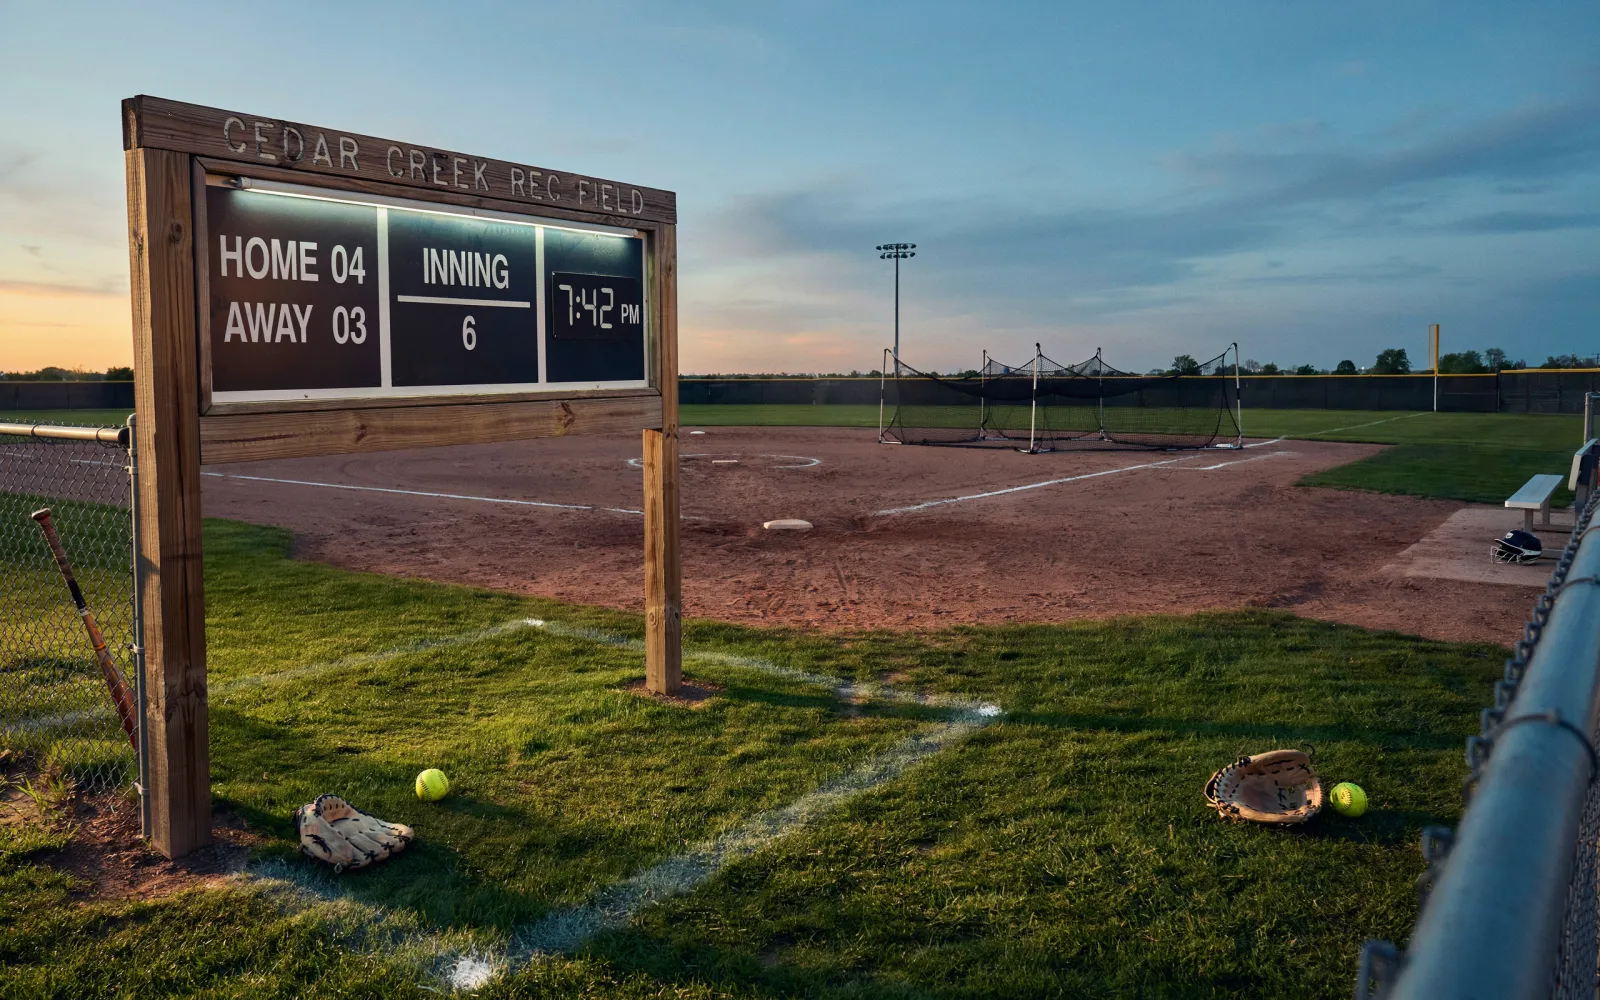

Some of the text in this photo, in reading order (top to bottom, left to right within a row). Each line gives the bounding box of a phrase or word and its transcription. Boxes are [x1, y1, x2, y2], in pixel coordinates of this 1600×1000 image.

[223, 116, 643, 214] CEDAR CREEK REC FIELD
[219, 234, 366, 284] HOME 04
[423, 247, 509, 289] INNING
[224, 301, 367, 344] AWAY 03
[558, 284, 640, 329] 7:42 PM
[462, 315, 477, 351] 6
